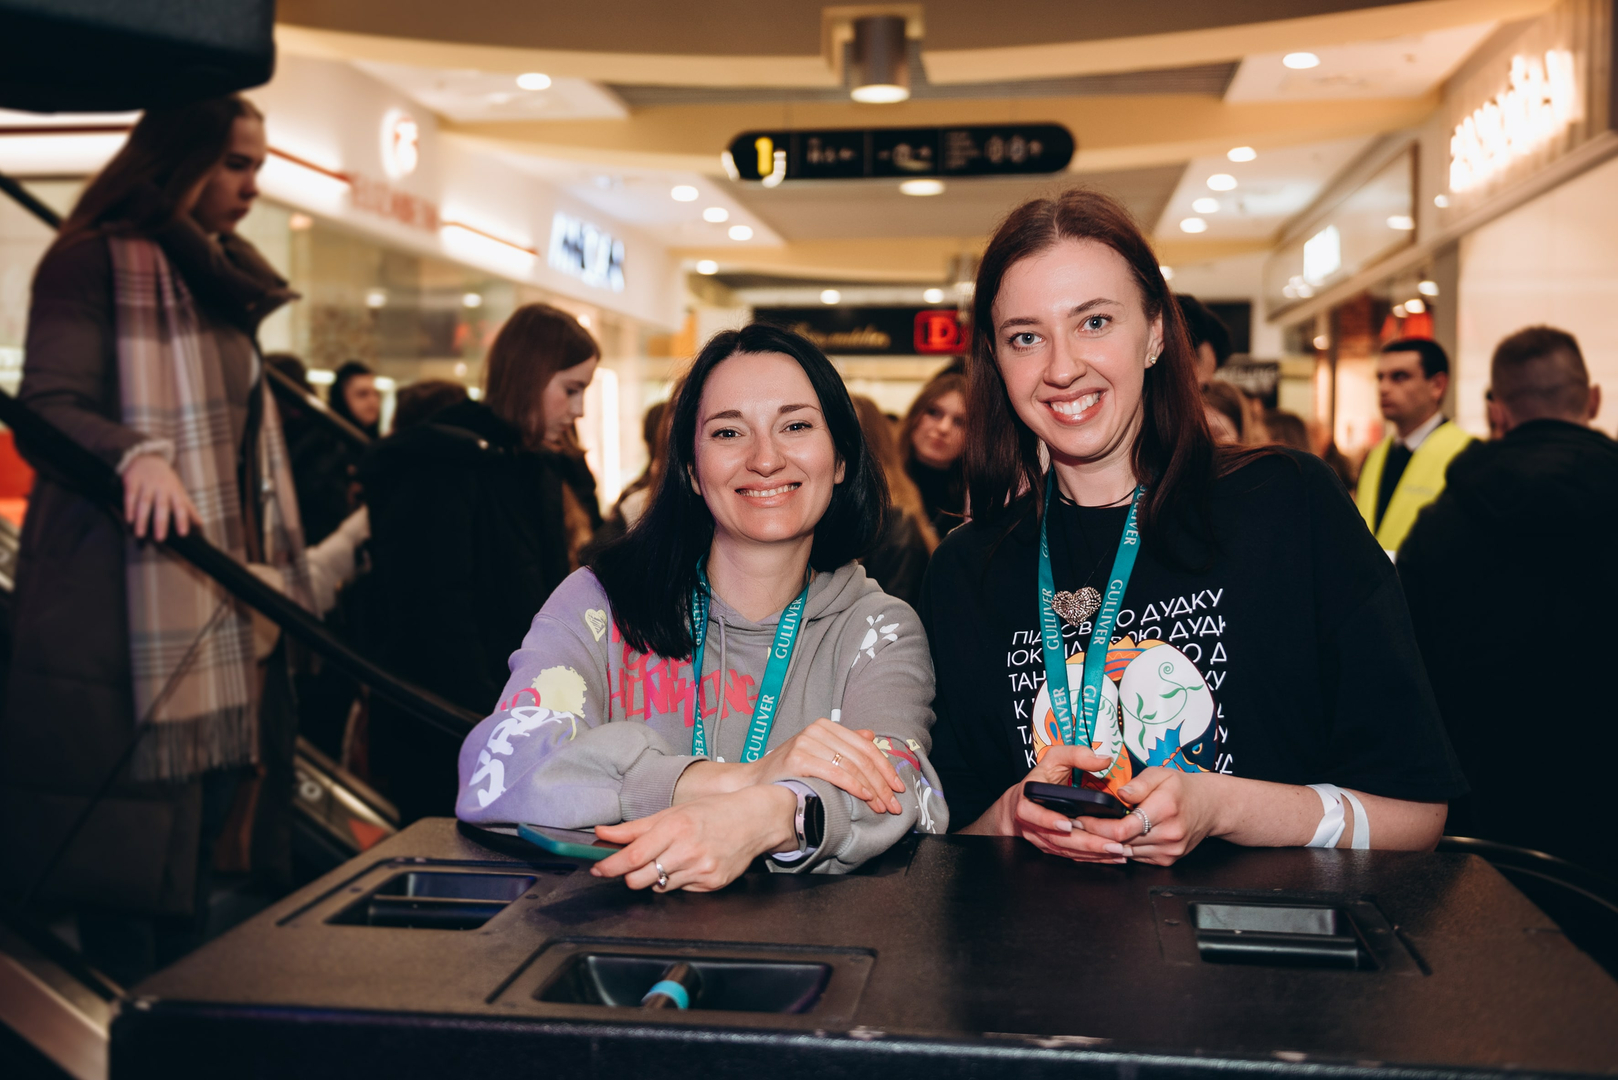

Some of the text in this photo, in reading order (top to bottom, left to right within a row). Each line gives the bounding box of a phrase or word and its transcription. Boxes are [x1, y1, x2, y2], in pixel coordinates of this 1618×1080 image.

[775, 597, 803, 660] GULLIVER
[1042, 588, 1060, 650] GULLIVER
[1093, 579, 1123, 645] GULLIVER
[1140, 588, 1223, 626] ДУДКУ
[746, 694, 776, 764] GULLIVER
